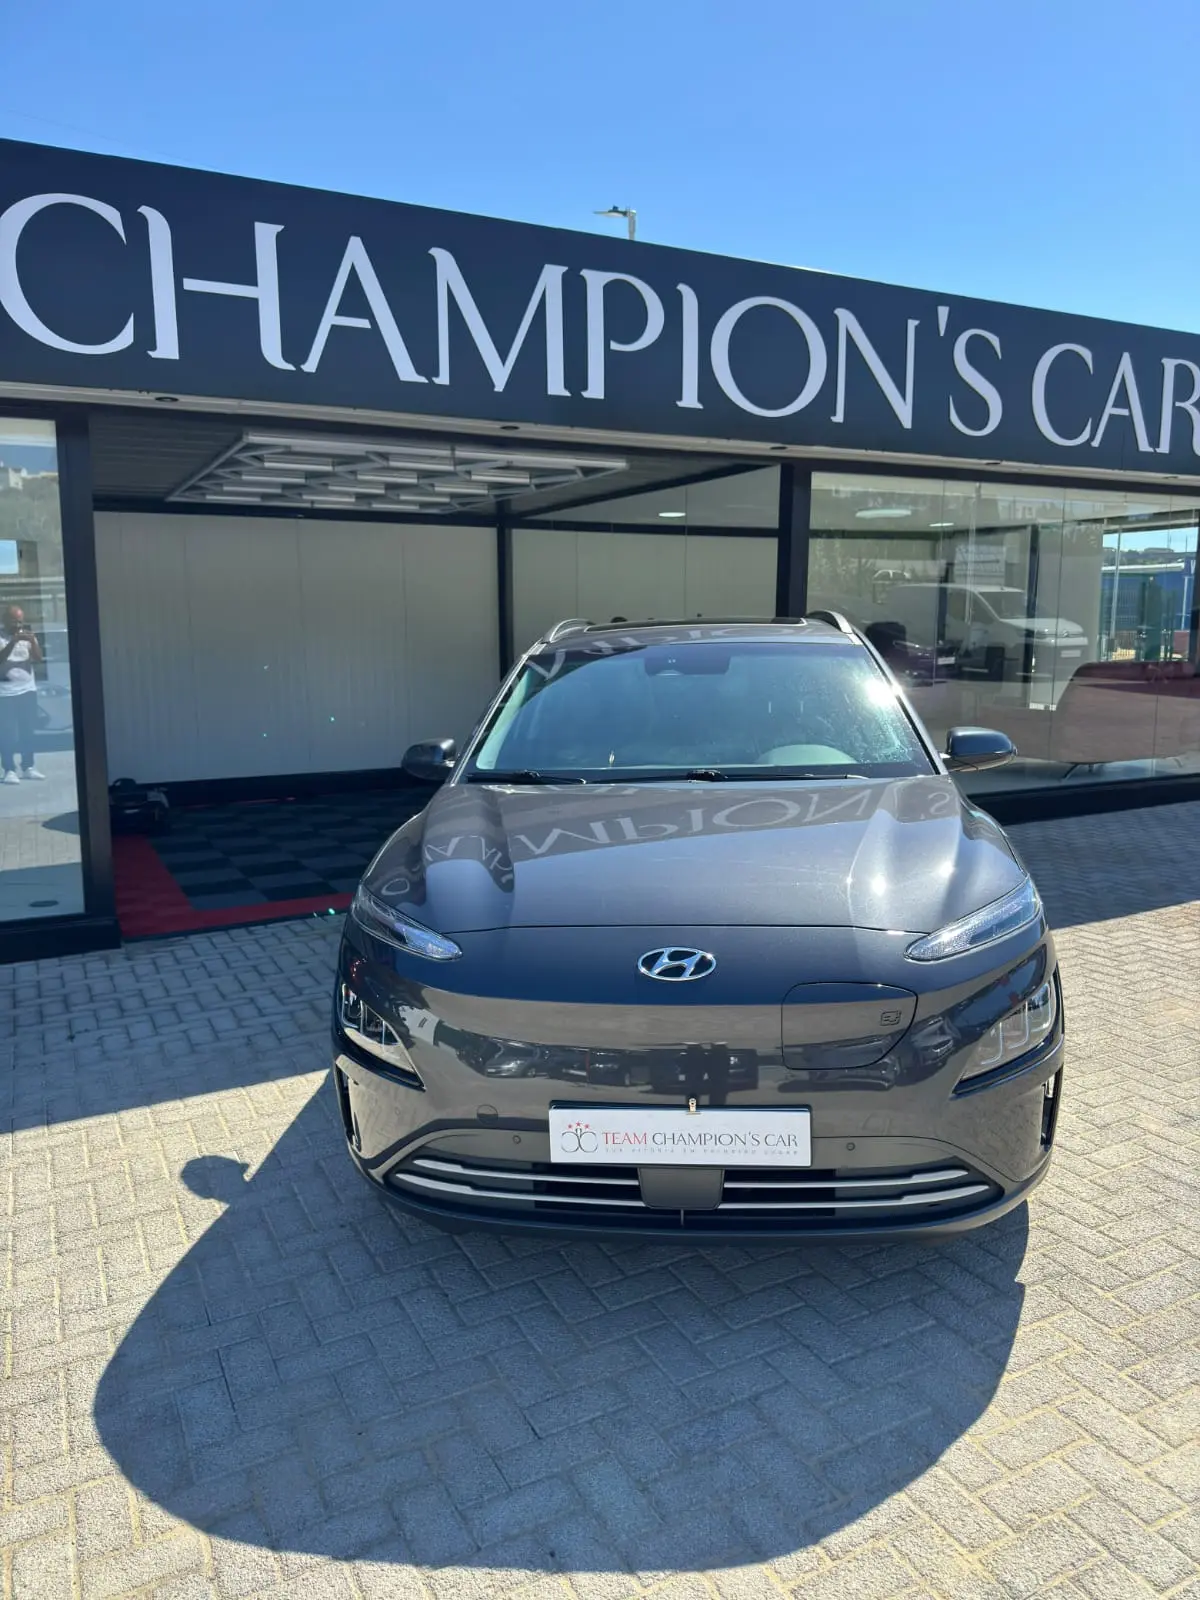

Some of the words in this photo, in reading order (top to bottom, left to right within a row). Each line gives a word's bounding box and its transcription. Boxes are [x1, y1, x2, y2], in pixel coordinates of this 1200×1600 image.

[0, 192, 1003, 437] CHAMPION'S
[1031, 343, 1200, 457] CAR
[602, 1131, 648, 1145] TEAM
[652, 1131, 761, 1147] CHAMPION'S
[764, 1133, 799, 1148] CAR
